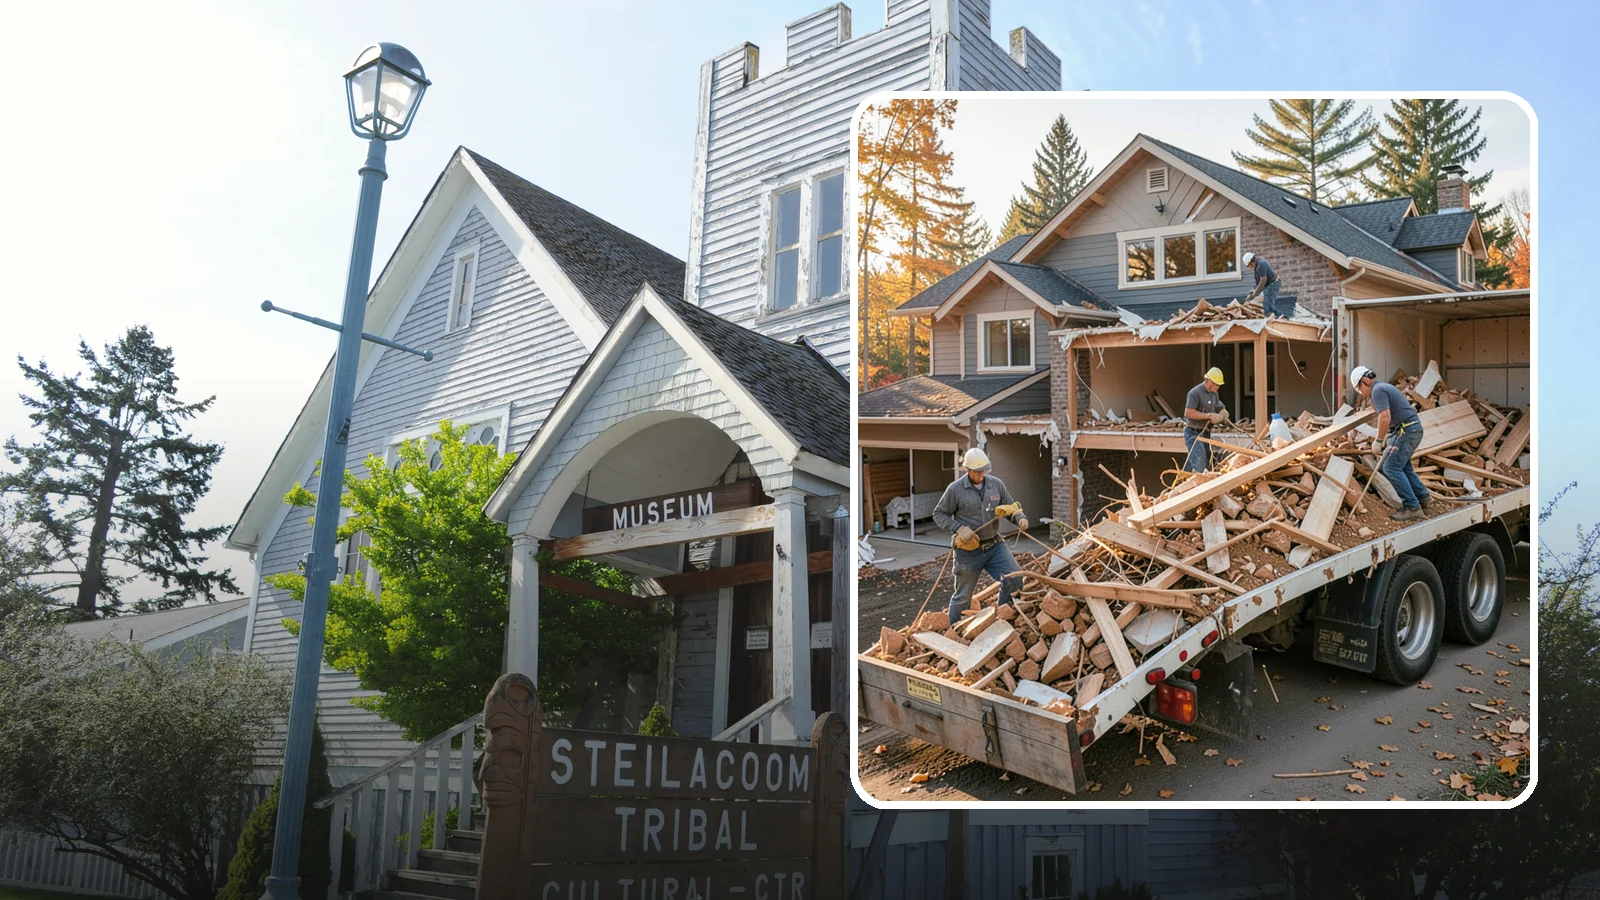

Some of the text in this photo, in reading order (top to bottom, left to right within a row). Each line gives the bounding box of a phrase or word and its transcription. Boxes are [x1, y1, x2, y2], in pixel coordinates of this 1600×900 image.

[613, 491, 713, 530] MUSEUM
[550, 738, 809, 792] STEILACOOM
[615, 807, 757, 851] TRIBAL
